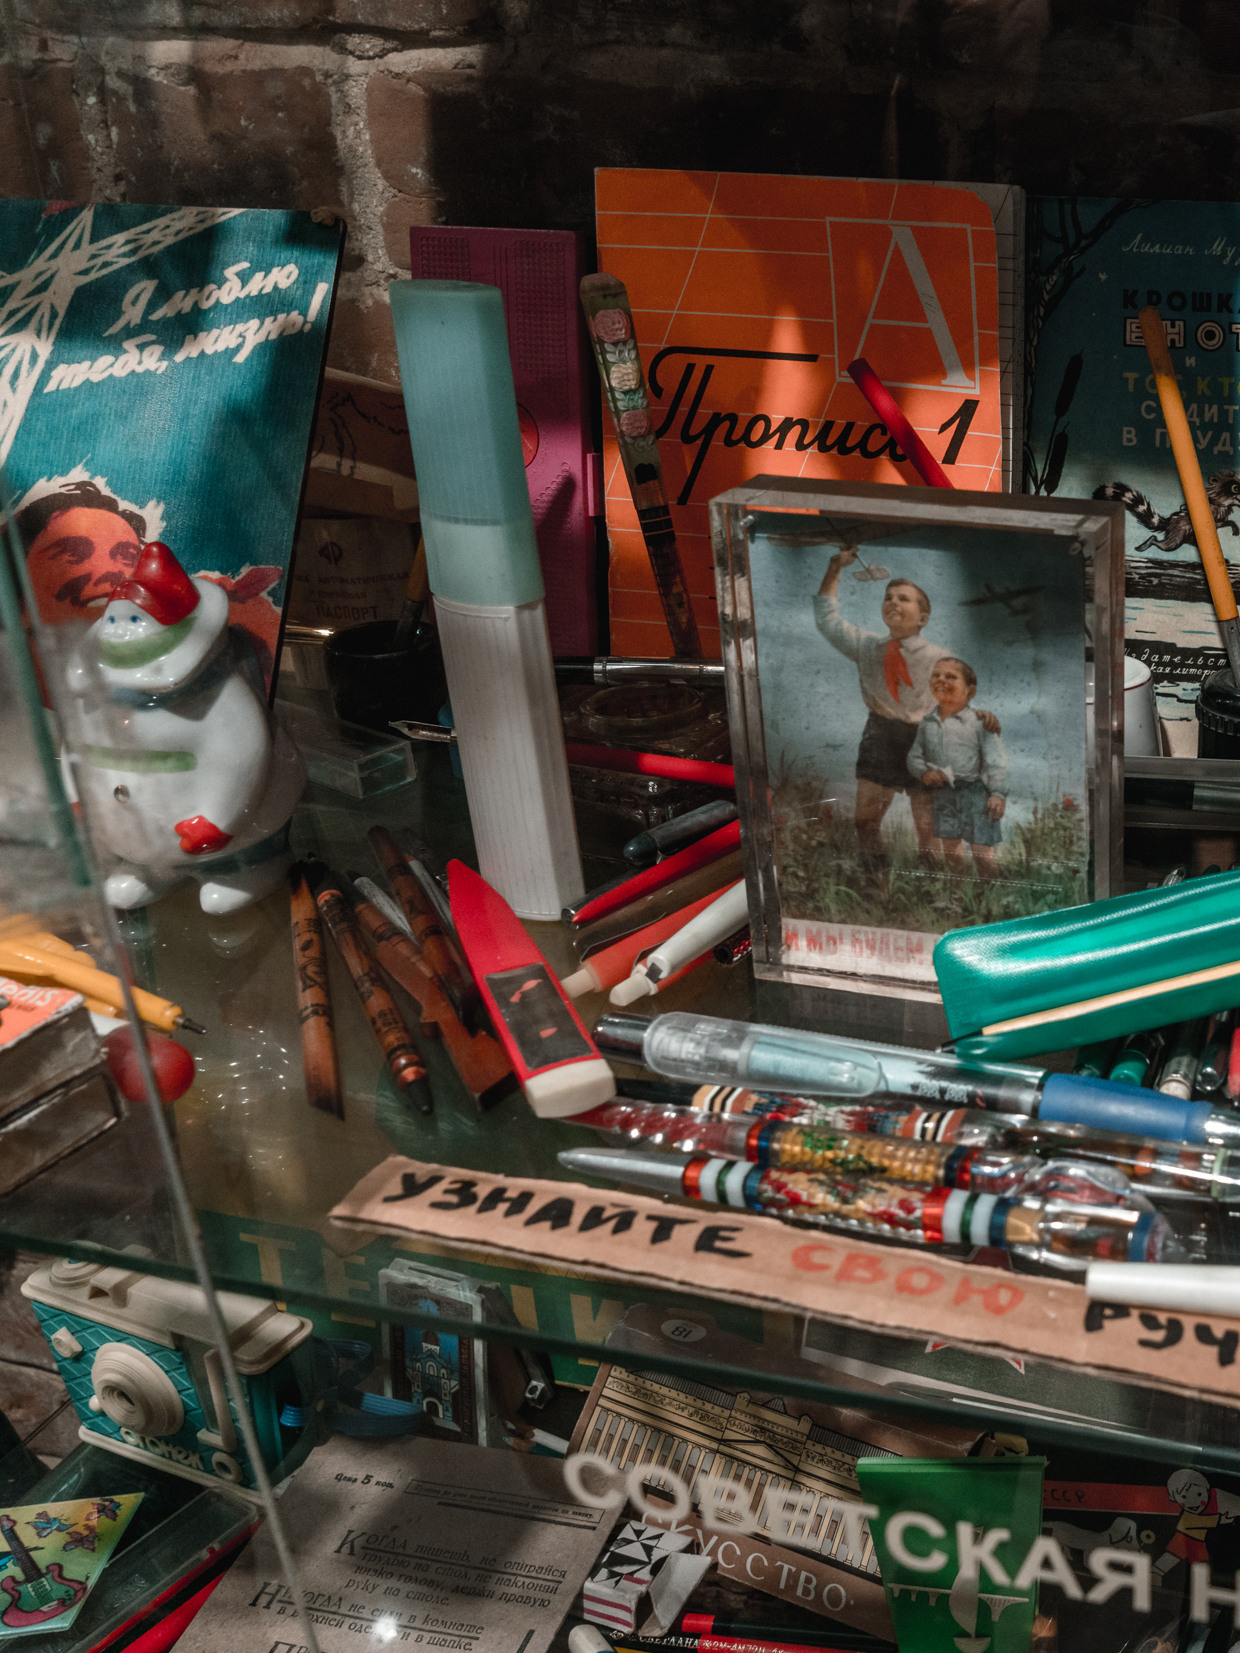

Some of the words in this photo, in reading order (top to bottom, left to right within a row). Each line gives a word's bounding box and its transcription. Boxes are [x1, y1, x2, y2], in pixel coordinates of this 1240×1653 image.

[1121, 232, 1196, 255] Лилиан
[102, 279, 159, 337] Я
[149, 261, 299, 320] люблю
[841, 225, 974, 388] А
[43, 334, 169, 393] тебя,
[174, 282, 329, 363] жизнь!
[1122, 371, 1187, 397] ТО,
[1140, 400, 1239, 427] СДИТ
[938, 399, 980, 465] 1
[1122, 427, 1137, 446] В
[318, 571, 410, 583] АВТОМАТИЧЕСКАЯ
[315, 603, 377, 620] ПАСПОРТ
[1124, 647, 1227, 666] Издательст
[849, 929, 924, 963] БУДЕМ
[382, 1171, 753, 1259] УЗНАЙТЕ
[790, 1243, 1024, 1316] СВОЮ
[334, 1472, 358, 1484] Цена
[361, 1474, 371, 1485] 5
[374, 1479, 394, 1489] коп.
[564, 1452, 1152, 1613] СОВЕТСКАЯ
[334, 1528, 407, 1561] КОГДА
[414, 1543, 471, 1563] пишешь,
[479, 1554, 496, 1565] не
[503, 1559, 567, 1578] опирайся
[353, 1564, 394, 1580] низко
[397, 1573, 445, 1591] голову,
[451, 1581, 495, 1599] держи
[498, 1590, 551, 1609] правую
[361, 1552, 409, 1571] грудью
[413, 1561, 430, 1573] на
[434, 1565, 472, 1581] стол,
[475, 1571, 491, 1583] не
[494, 1574, 558, 1594] наклоняй
[345, 1577, 379, 1595] руку
[383, 1584, 402, 1597] на
[405, 1587, 451, 1605] столе.
[348, 1602, 366, 1614] не
[407, 1613, 416, 1623] в
[422, 1614, 484, 1635] комнате
[401, 1628, 411, 1641] и
[414, 1630, 423, 1642] в
[425, 1633, 474, 1652] шапке.
